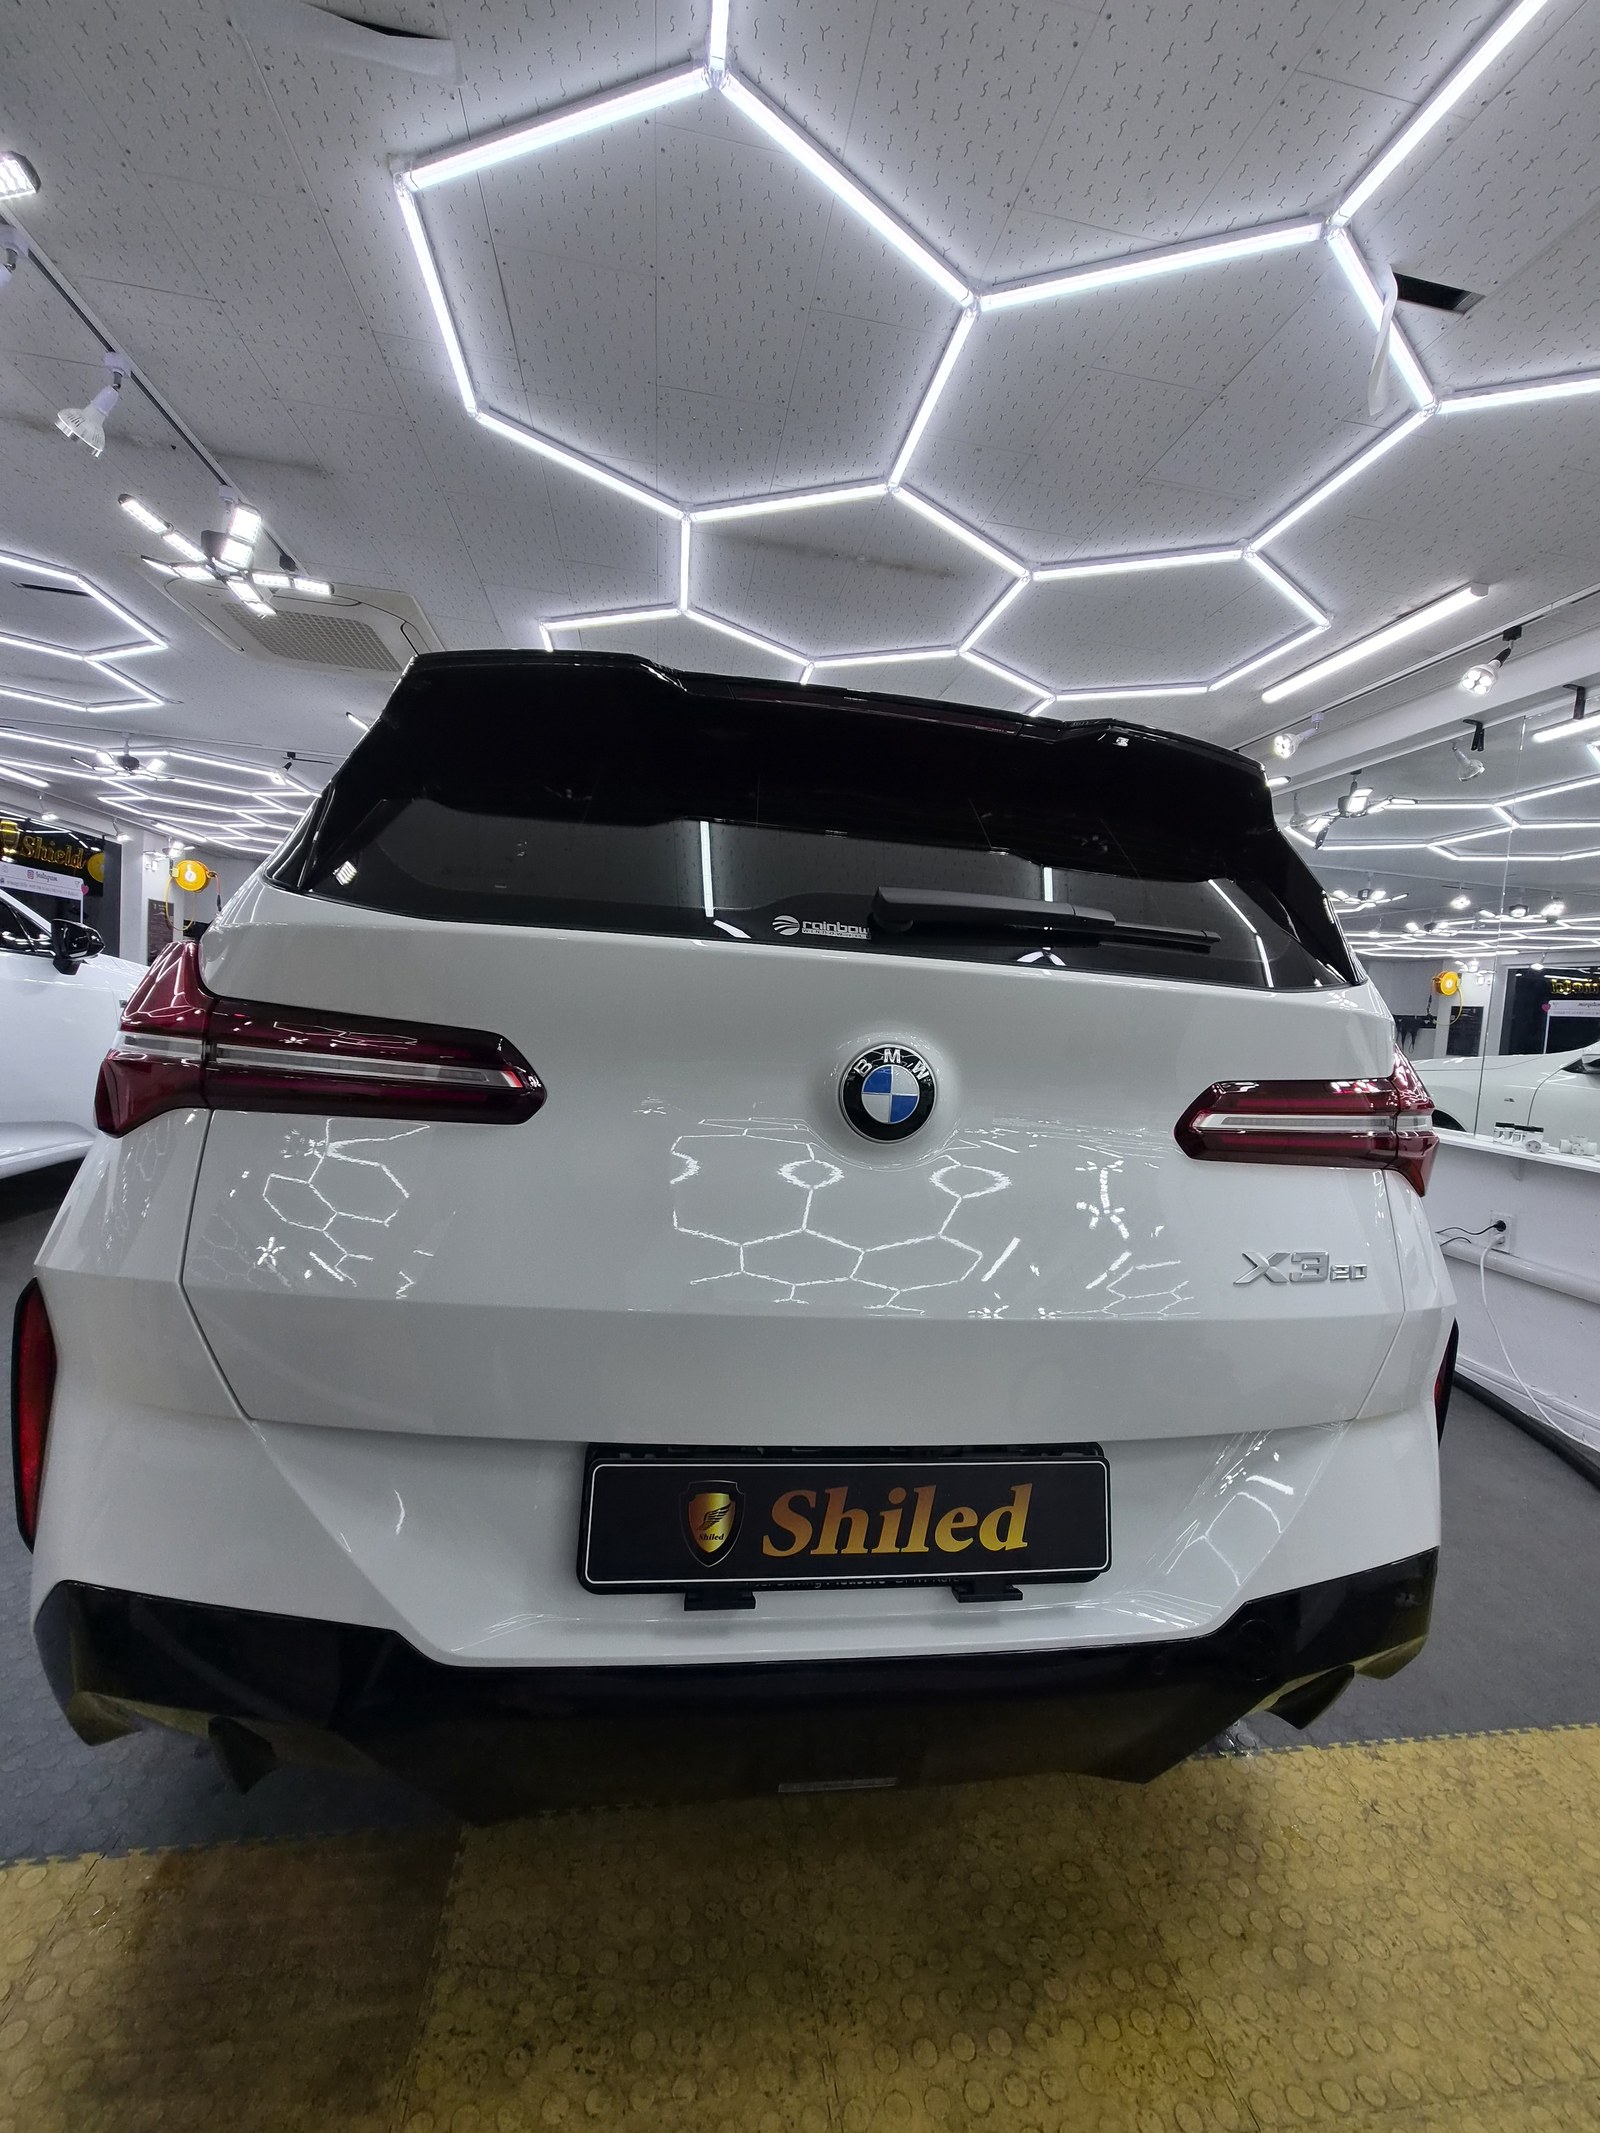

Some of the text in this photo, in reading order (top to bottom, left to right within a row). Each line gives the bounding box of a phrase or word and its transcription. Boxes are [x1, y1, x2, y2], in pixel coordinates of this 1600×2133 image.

[802, 921, 870, 934] rainbow
[853, 1048, 930, 1080] BMW
[763, 1483, 1033, 1557] Shiled
